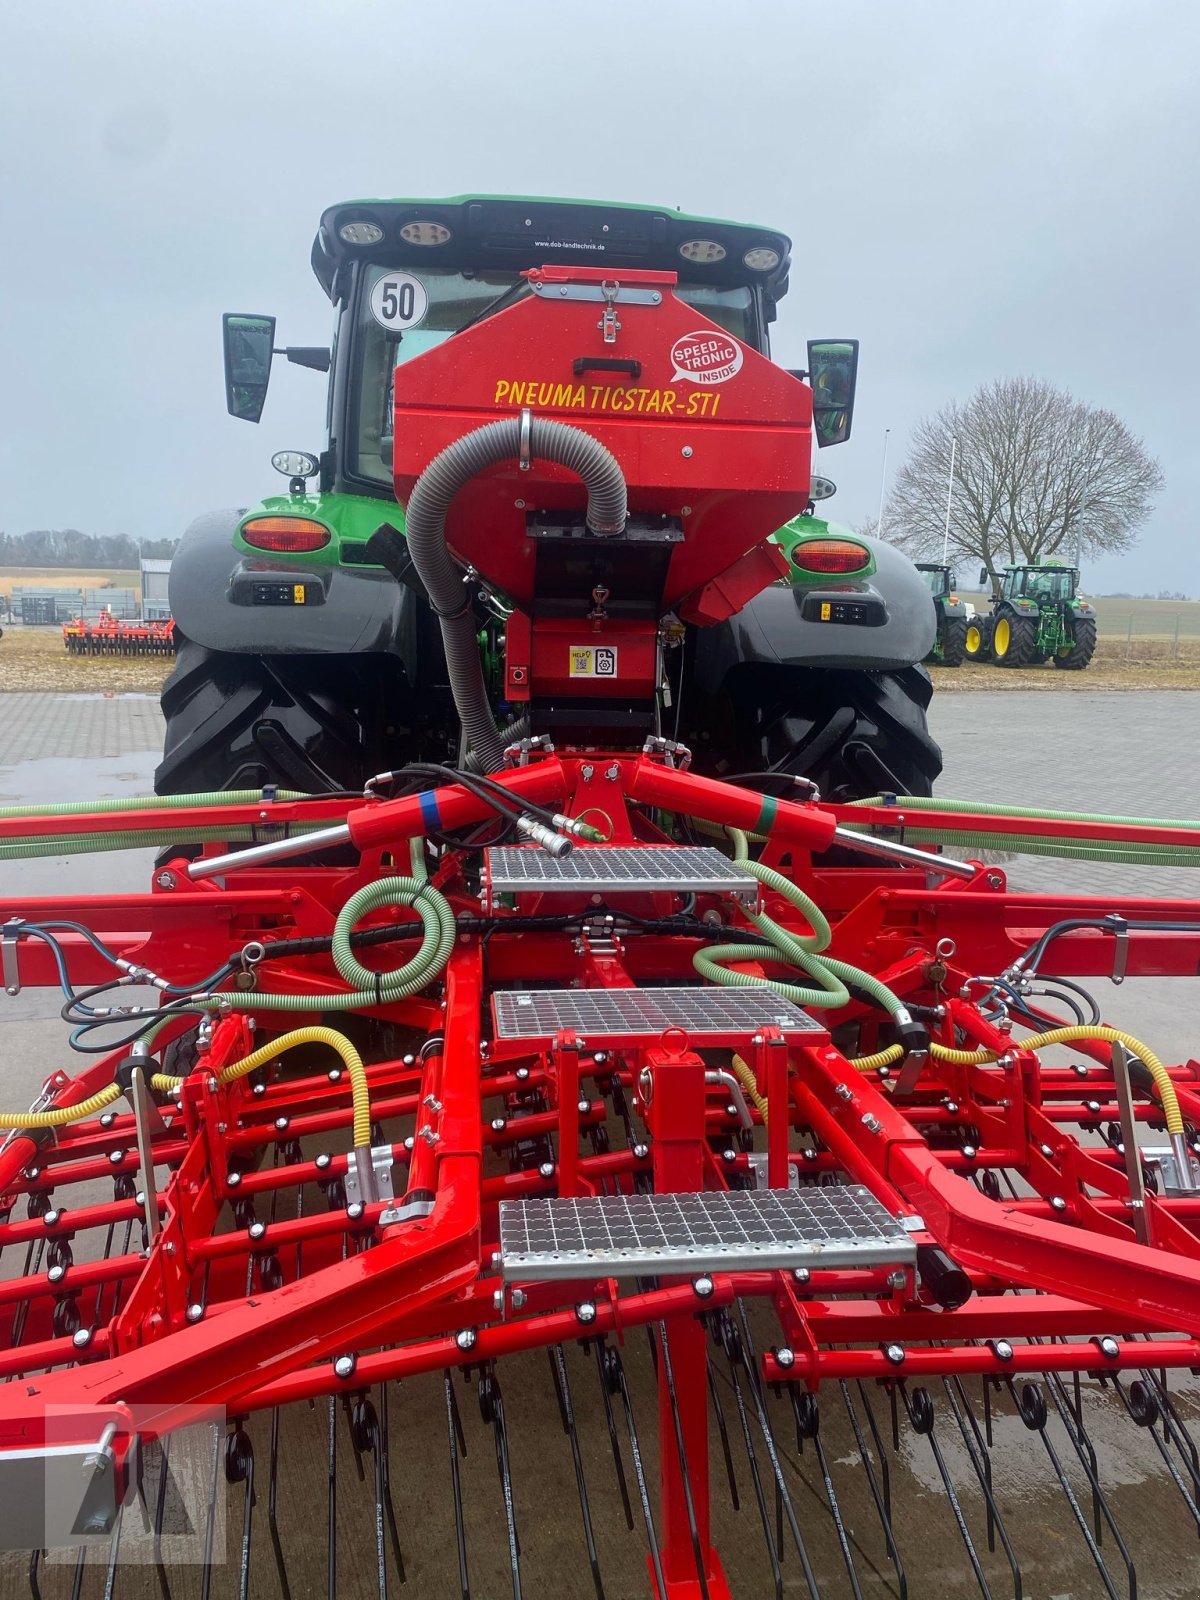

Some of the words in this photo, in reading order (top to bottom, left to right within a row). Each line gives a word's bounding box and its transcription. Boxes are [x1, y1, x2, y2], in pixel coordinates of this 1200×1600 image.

[535, 241, 606, 251] www.dob-landtechnik.de
[382, 283, 415, 320] 50
[674, 341, 722, 361] SPEED-
[684, 348, 734, 370] TRONIC
[698, 364, 737, 382] INSIDE
